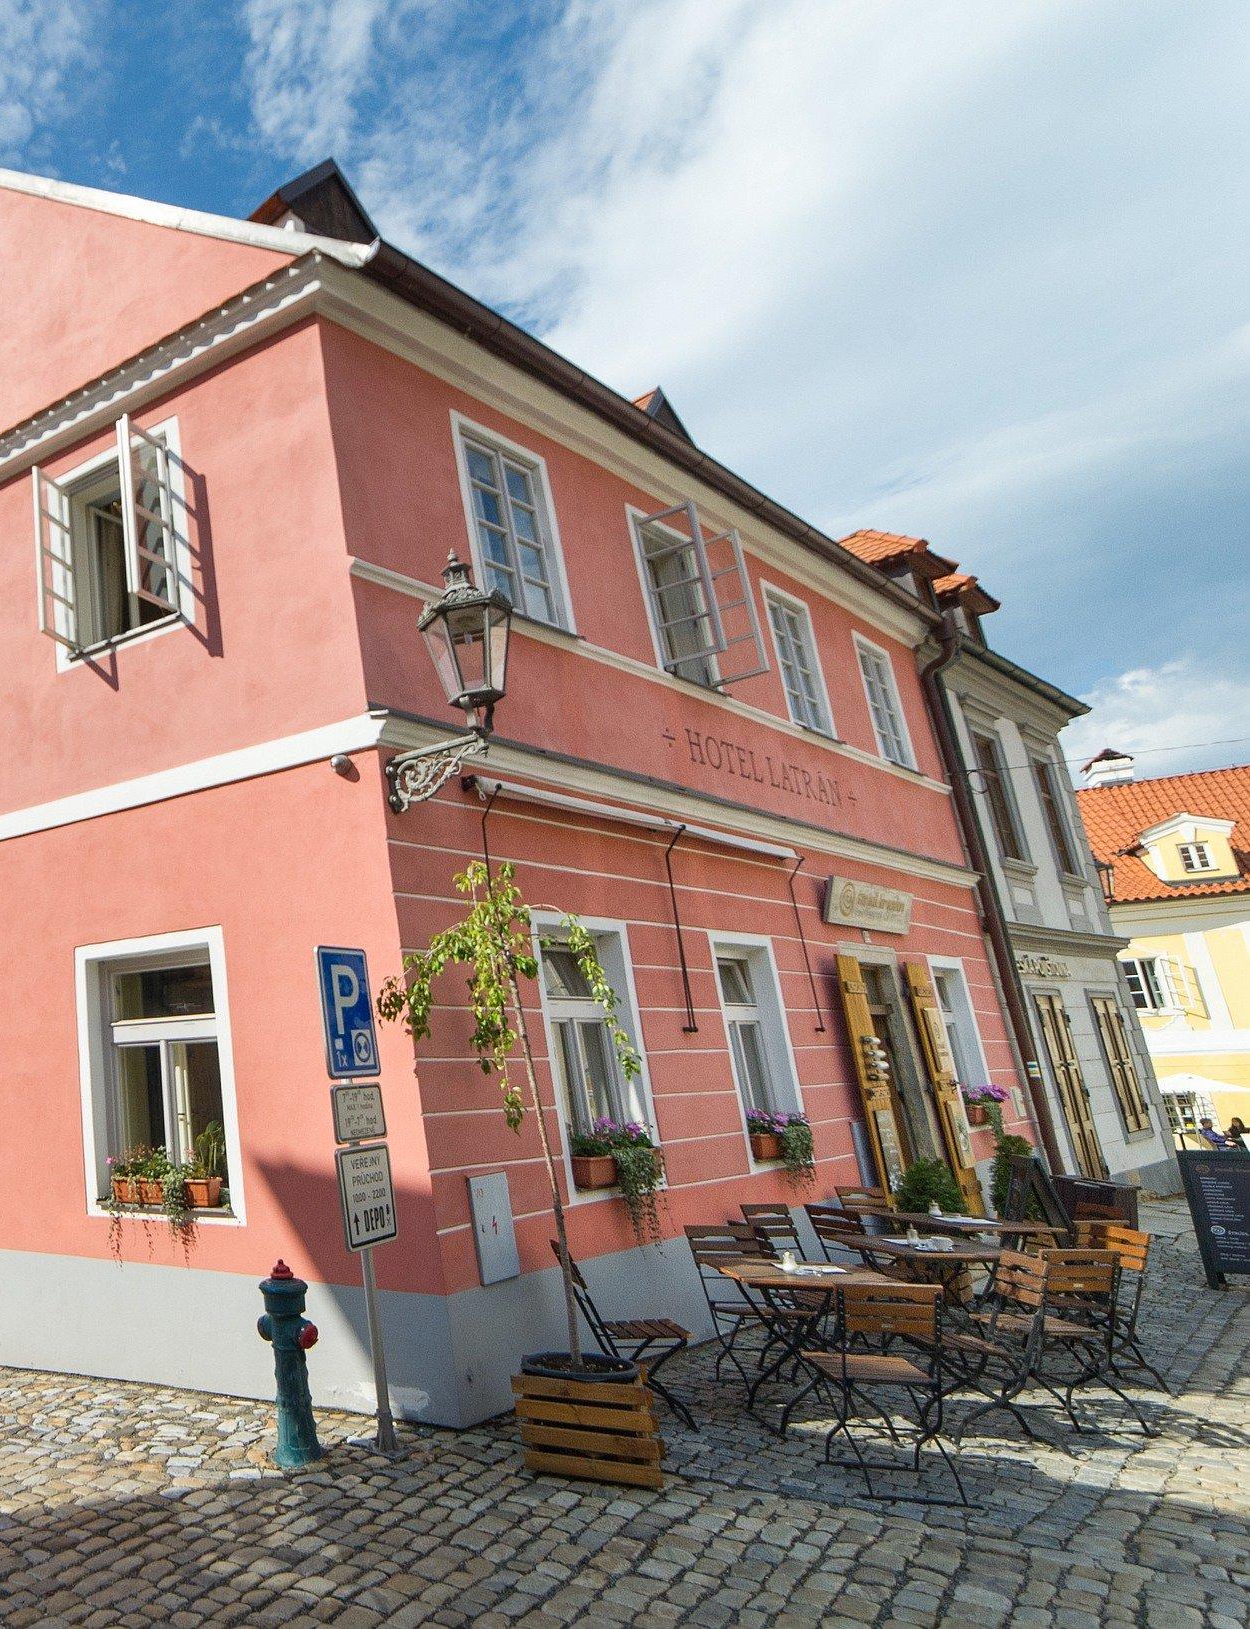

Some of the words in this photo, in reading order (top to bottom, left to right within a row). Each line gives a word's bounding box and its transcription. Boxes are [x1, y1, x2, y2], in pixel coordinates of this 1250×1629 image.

[684, 728, 763, 783] HOTEL
[766, 756, 842, 807] LATRÁN
[331, 964, 359, 1035] P
[350, 1153, 381, 1170] VEŘEJNÝ
[352, 1171, 384, 1187] PRŮCHOD
[363, 1205, 385, 1232] DEPO
